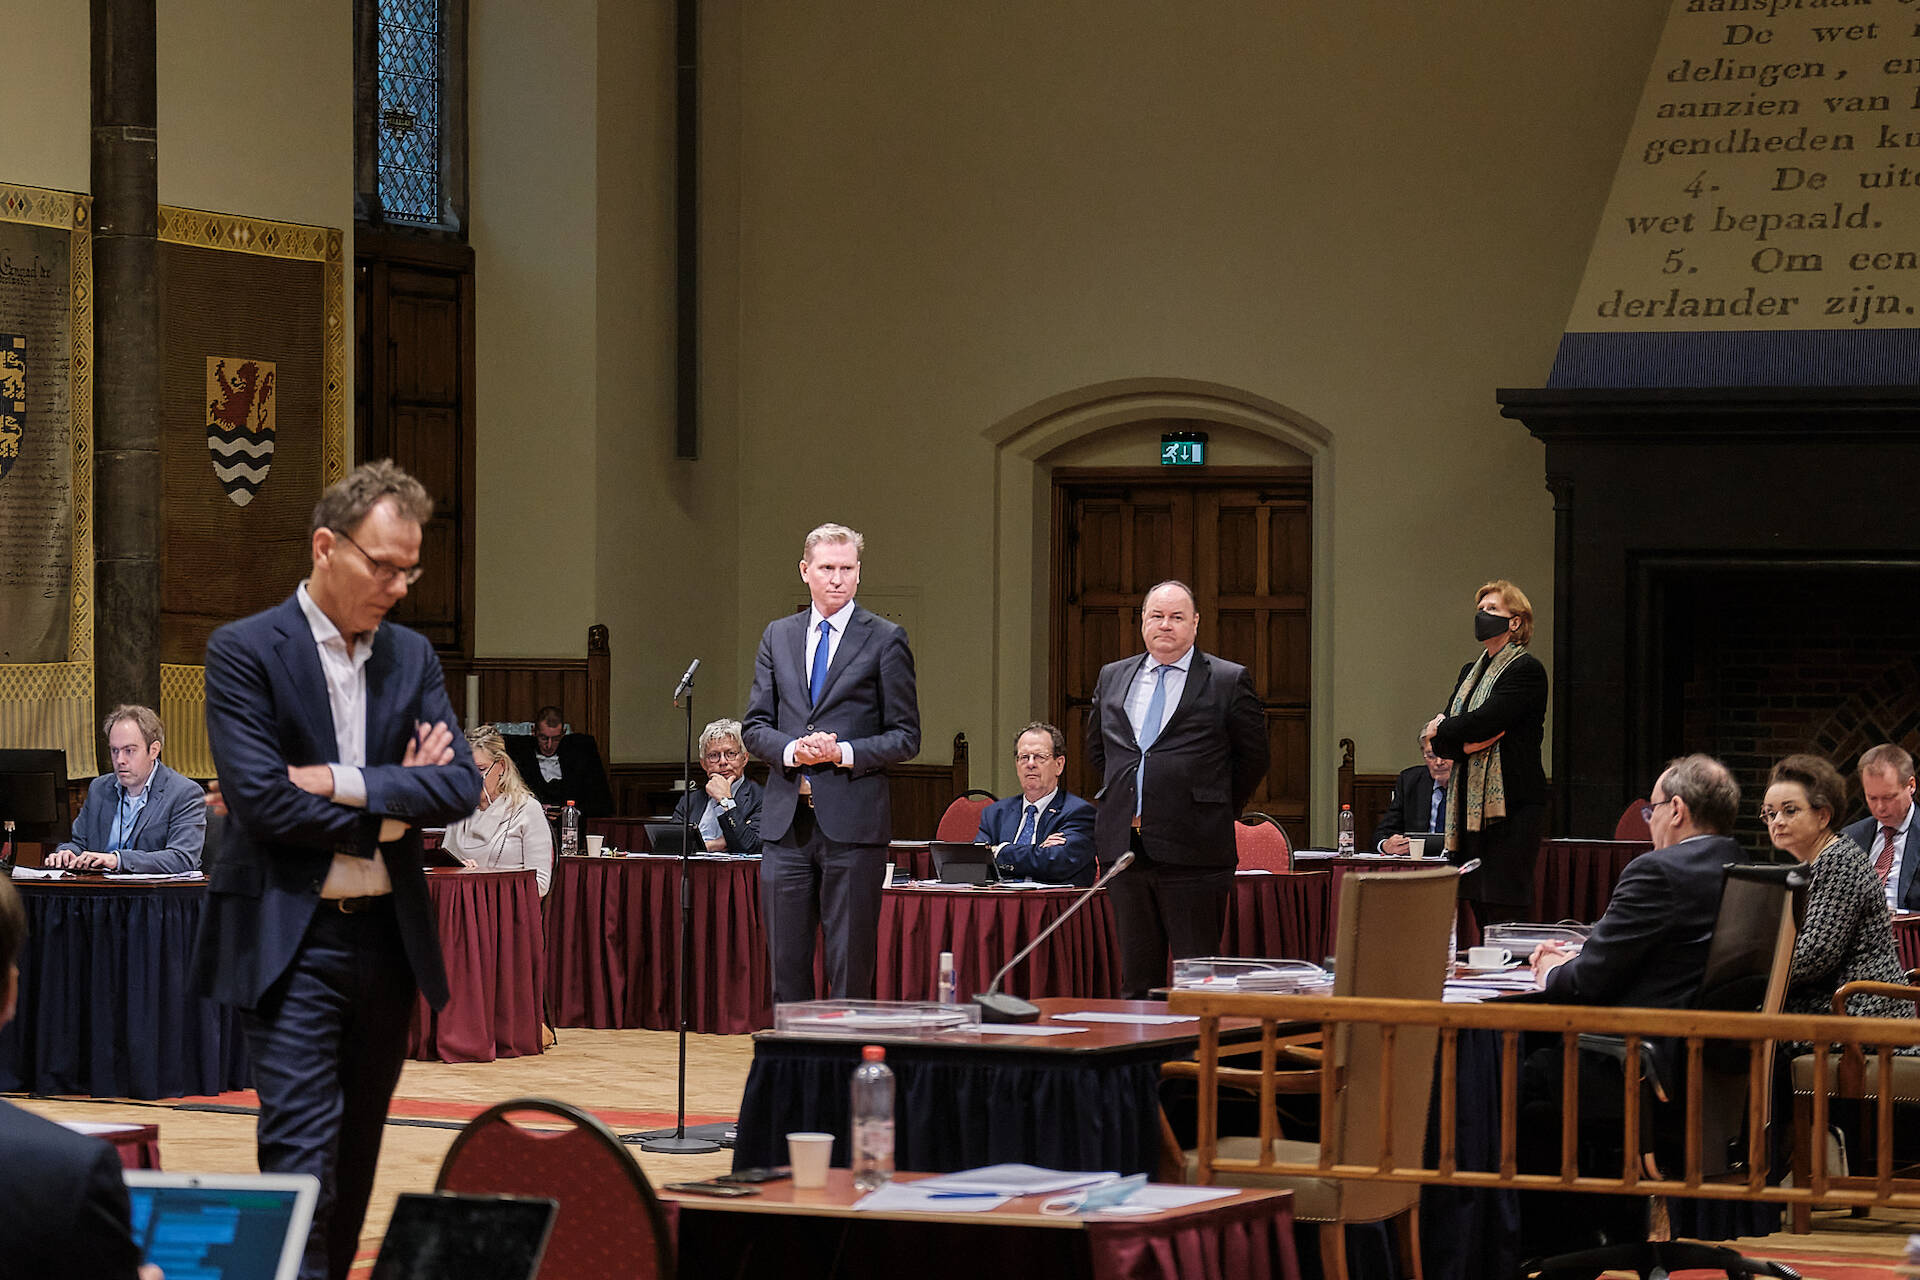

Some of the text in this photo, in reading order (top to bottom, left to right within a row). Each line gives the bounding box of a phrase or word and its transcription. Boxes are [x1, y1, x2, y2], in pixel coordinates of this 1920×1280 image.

[1686, 0, 1872, 17] aanspr
[1723, 23, 1879, 45] De wet
[1657, 93, 1800, 118] aanzien
[1824, 96, 1889, 113] van
[1643, 127, 1854, 164] gendheden
[1771, 168, 1827, 191] De
[1626, 202, 1882, 241] wet bepaald.
[1662, 248, 1917, 274] 5. Om een
[1598, 285, 1913, 324] derlander zijn.
